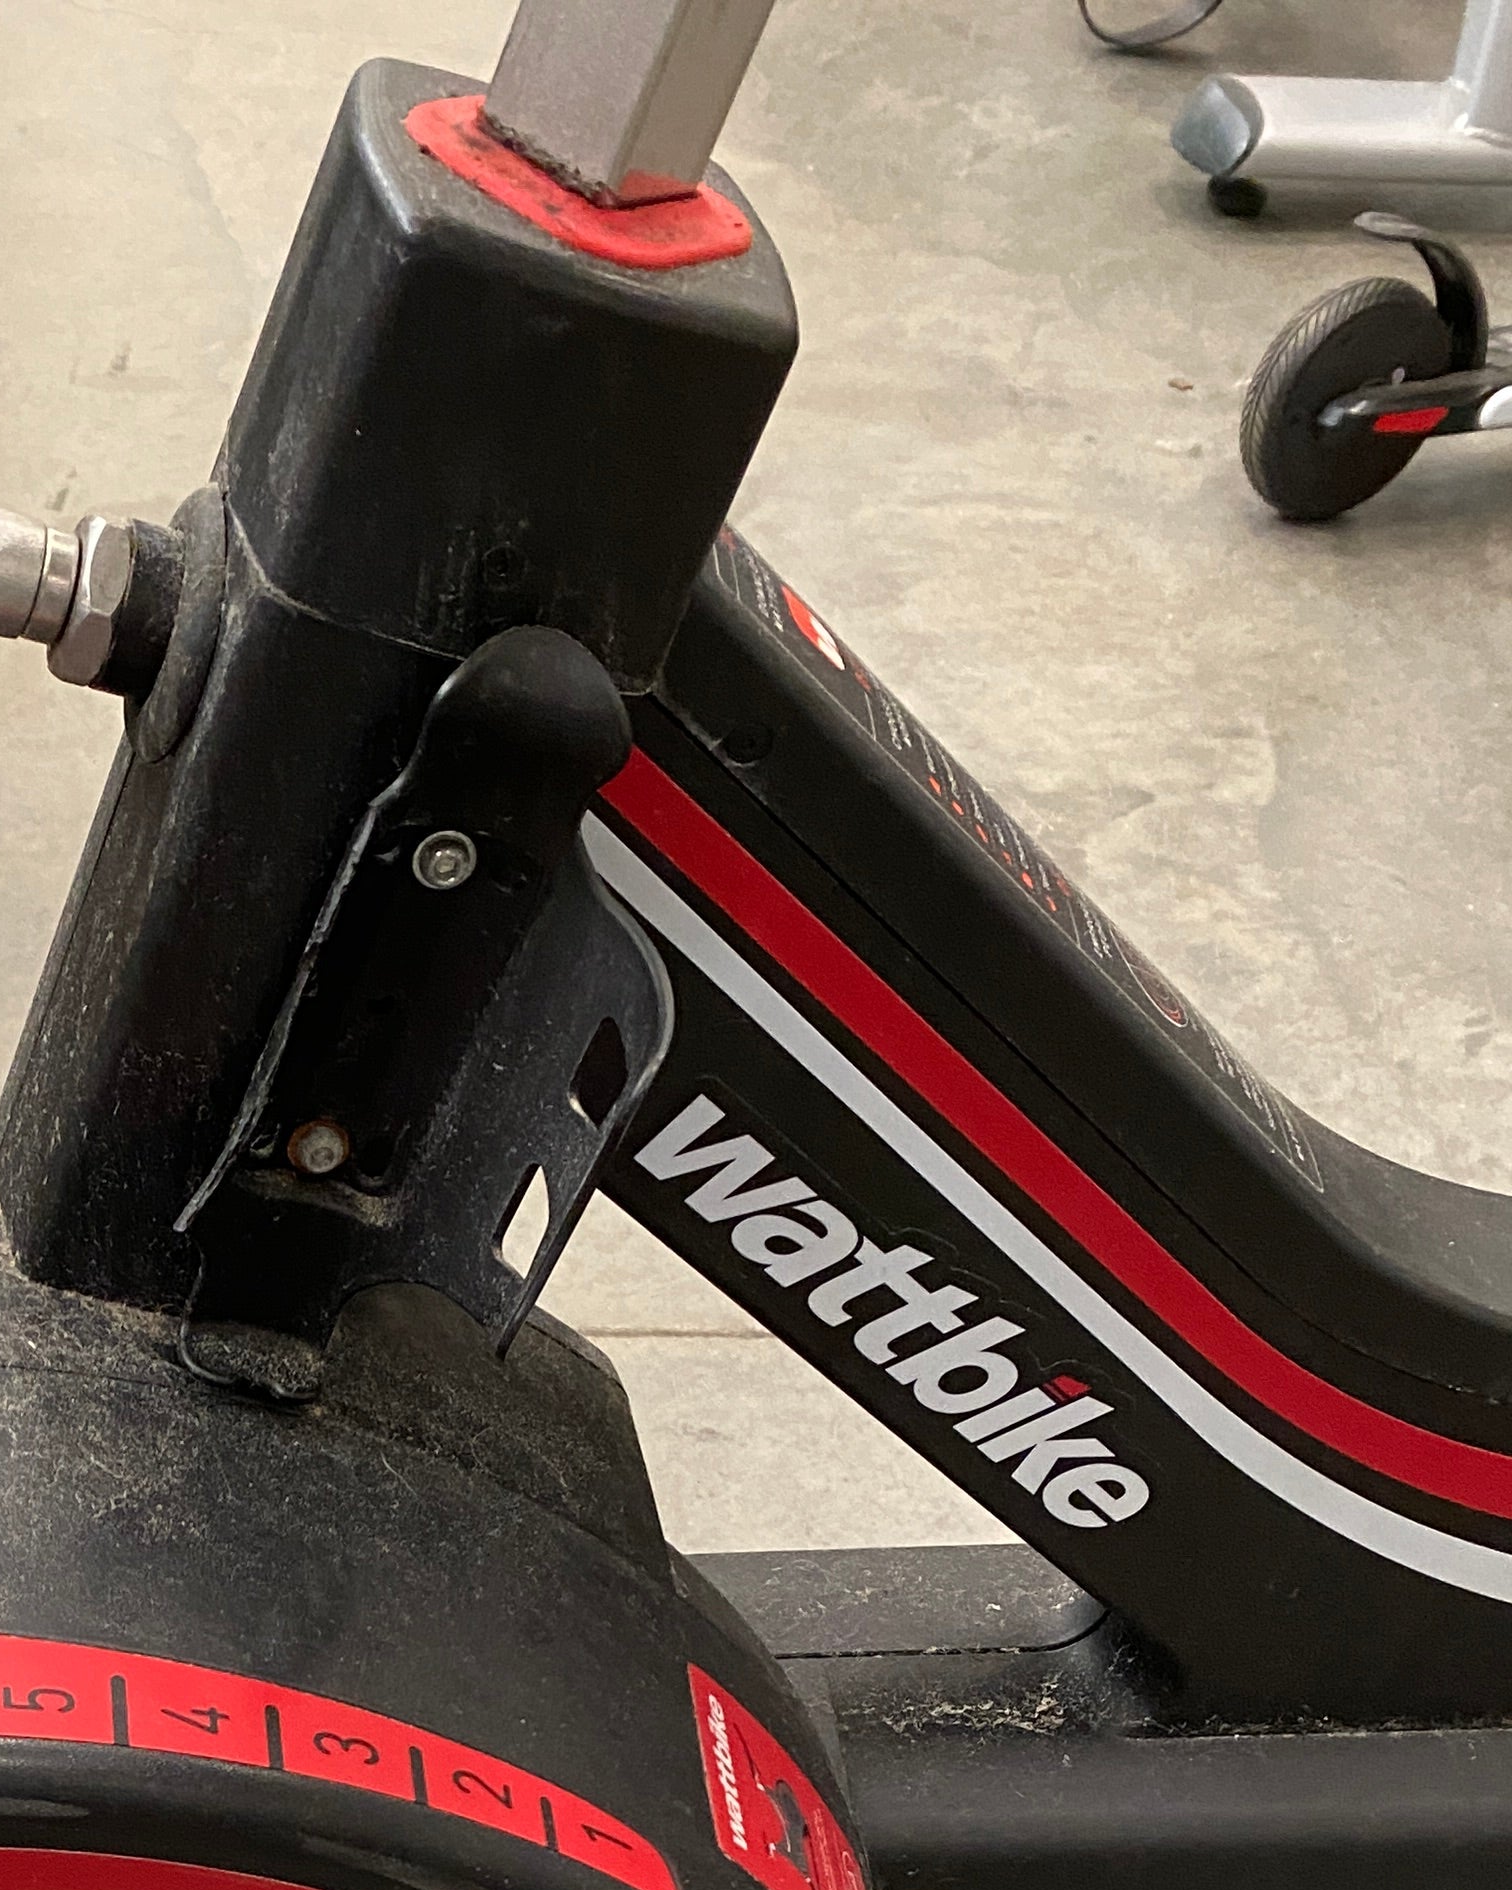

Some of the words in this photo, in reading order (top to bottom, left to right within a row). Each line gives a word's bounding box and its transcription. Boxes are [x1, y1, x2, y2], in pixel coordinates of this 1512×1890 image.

[633, 1092, 1151, 1529] wattbike
[2, 1685, 75, 1714] 5
[160, 1705, 230, 1735] 4
[313, 1731, 380, 1766] 3
[452, 1769, 513, 1810] 2
[707, 1693, 749, 1851] wattbike
[581, 1822, 633, 1851] 1
